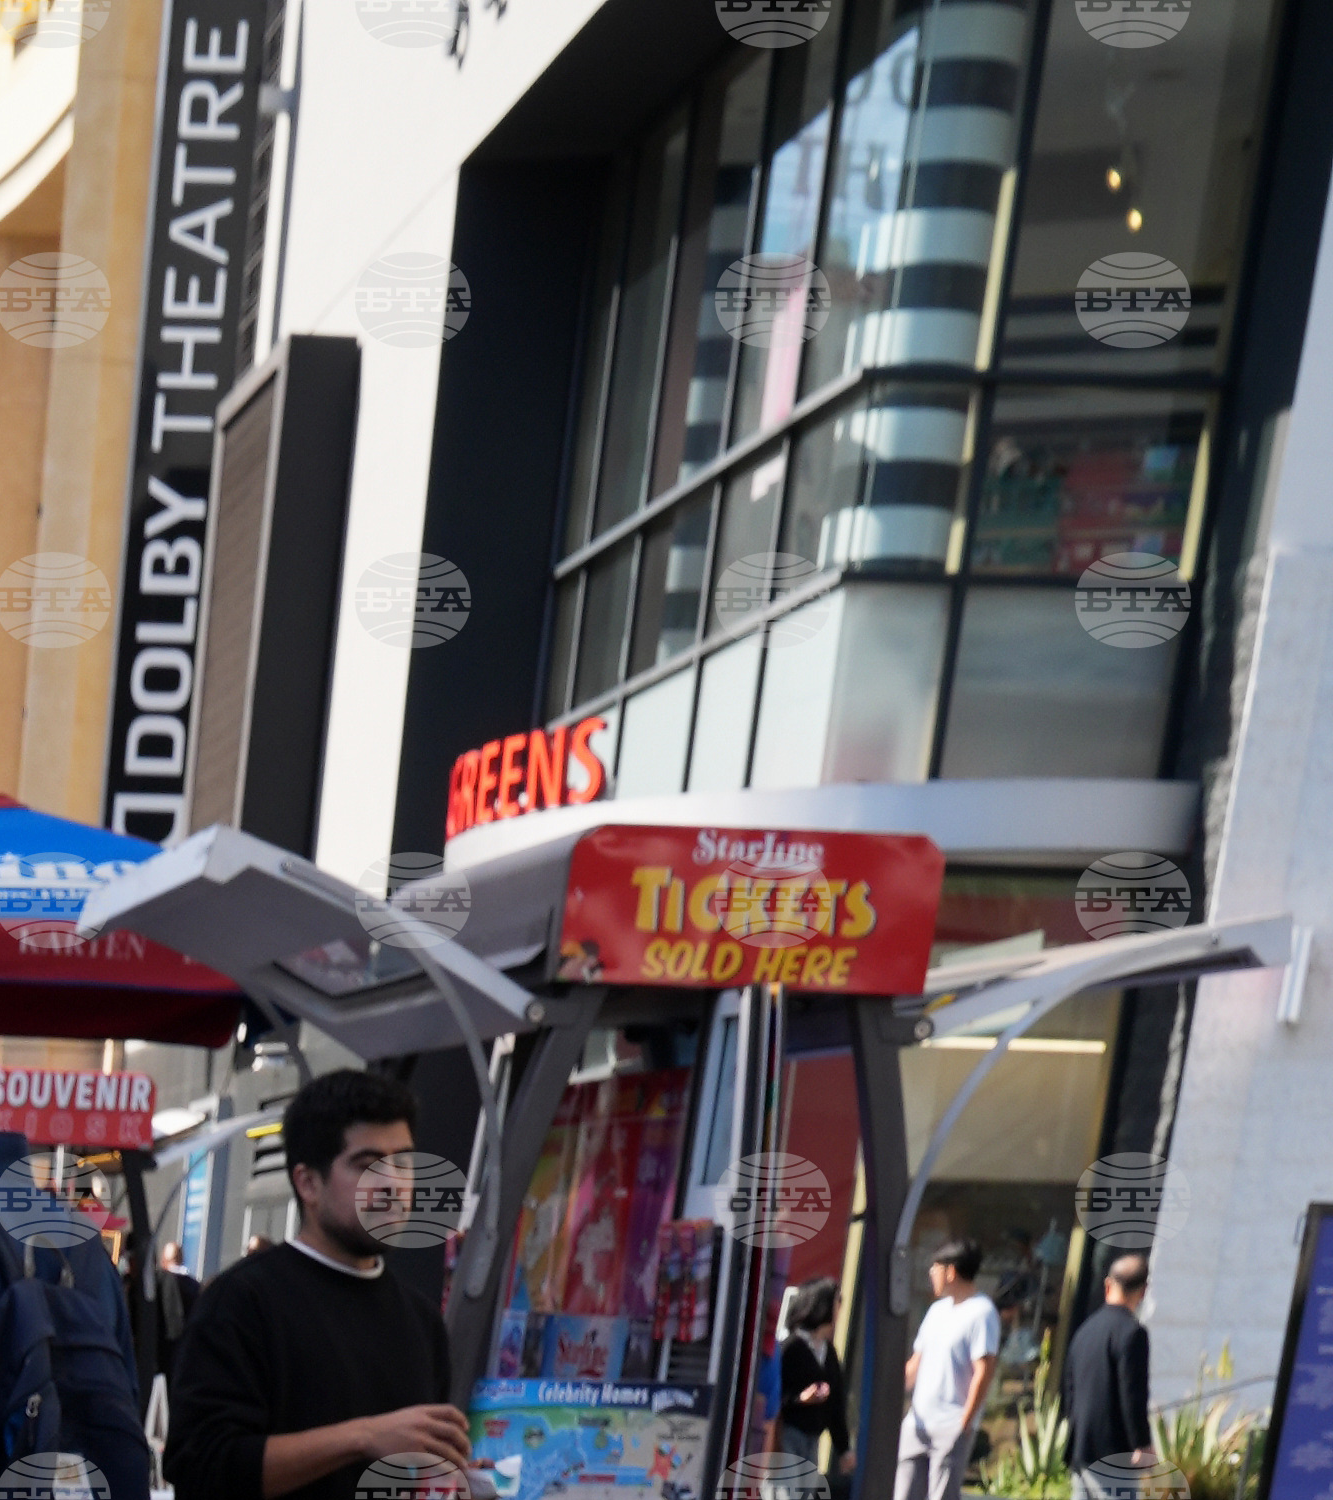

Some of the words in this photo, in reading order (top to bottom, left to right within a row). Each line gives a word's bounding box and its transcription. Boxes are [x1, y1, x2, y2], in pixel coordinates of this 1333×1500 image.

[150, 17, 249, 453] THEATRE
[124, 474, 207, 777] DOLBY
[632, 866, 877, 939] TICKETS
[641, 939, 743, 981] SOLD
[753, 945, 858, 987] HERE
